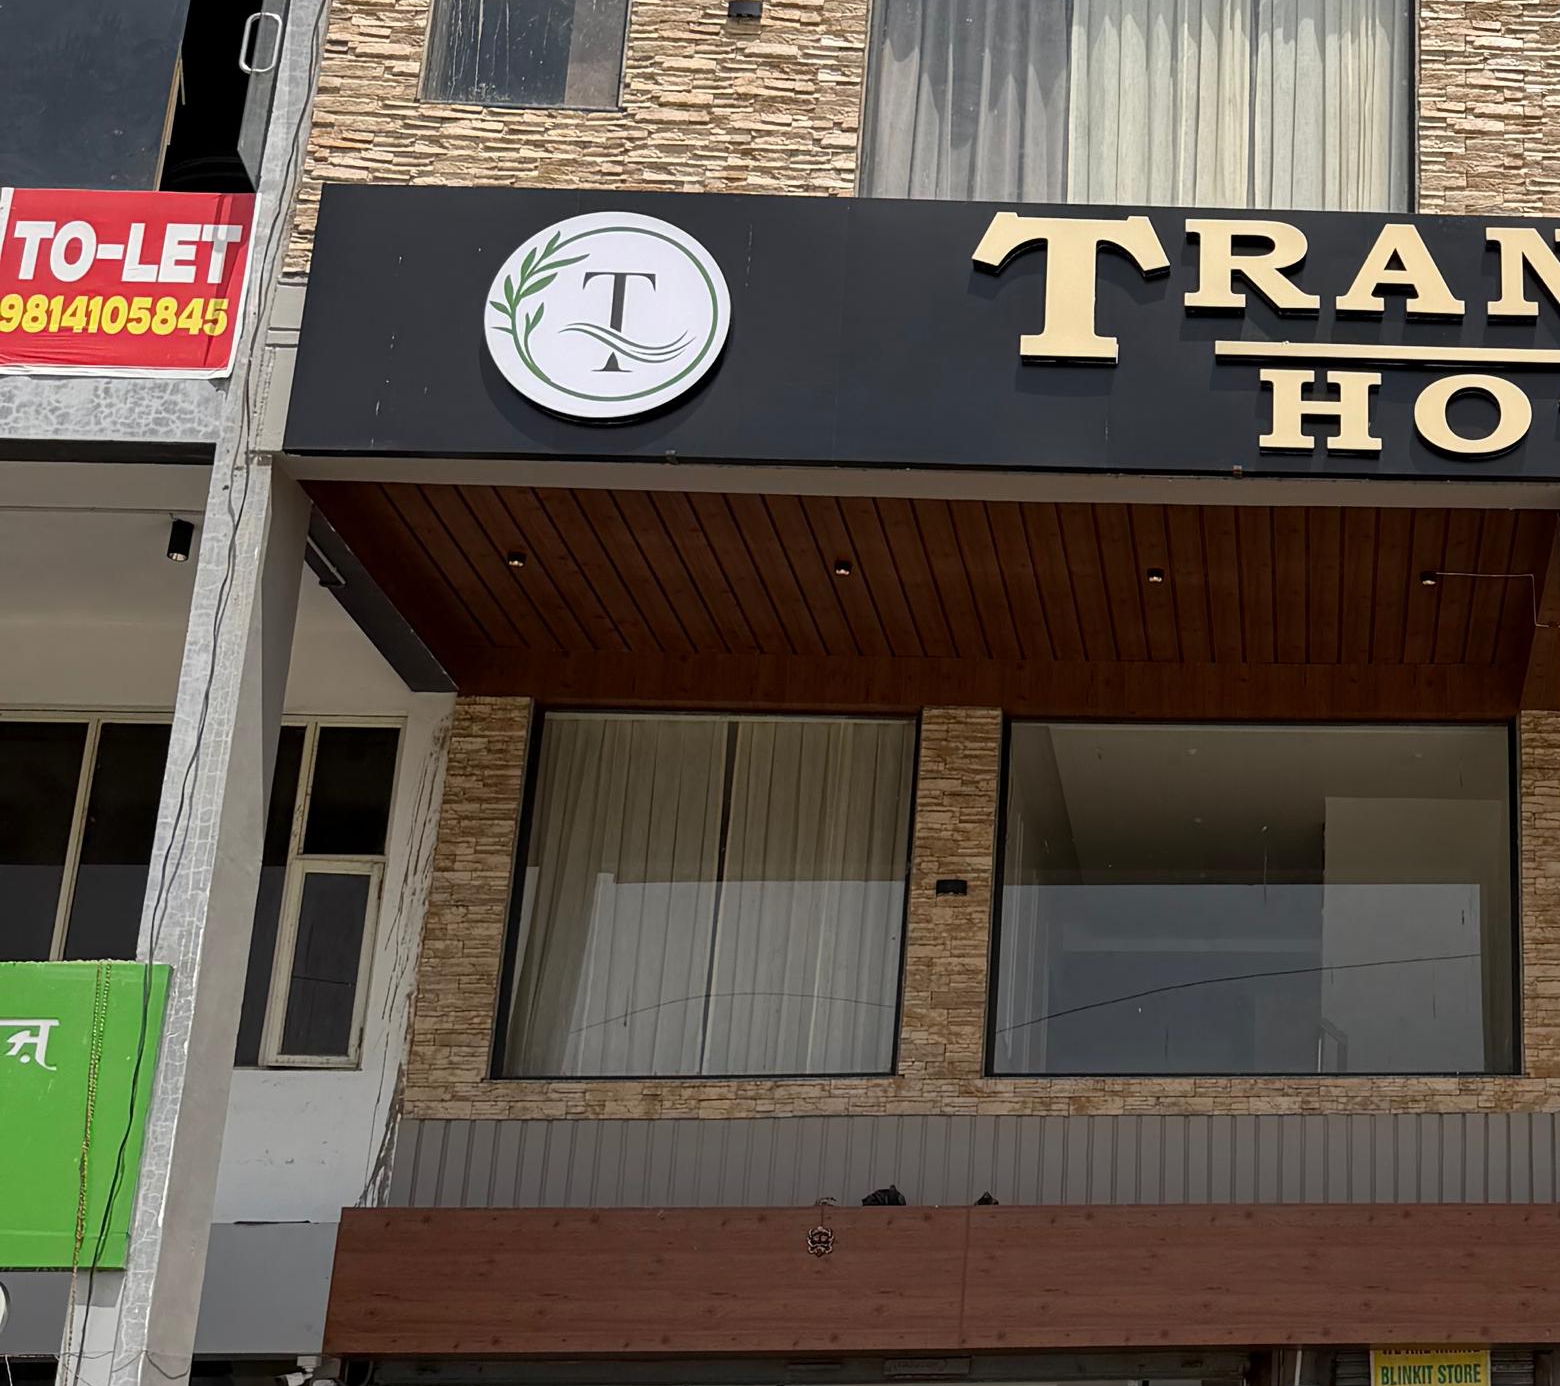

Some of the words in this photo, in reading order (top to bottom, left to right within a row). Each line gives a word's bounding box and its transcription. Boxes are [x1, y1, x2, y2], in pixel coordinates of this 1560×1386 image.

[14, 220, 243, 284] TO-LET
[0, 293, 229, 336] 9814105845
[1380, 1365, 1434, 1386] BLINKIT
[1437, 1363, 1482, 1385] STORE
